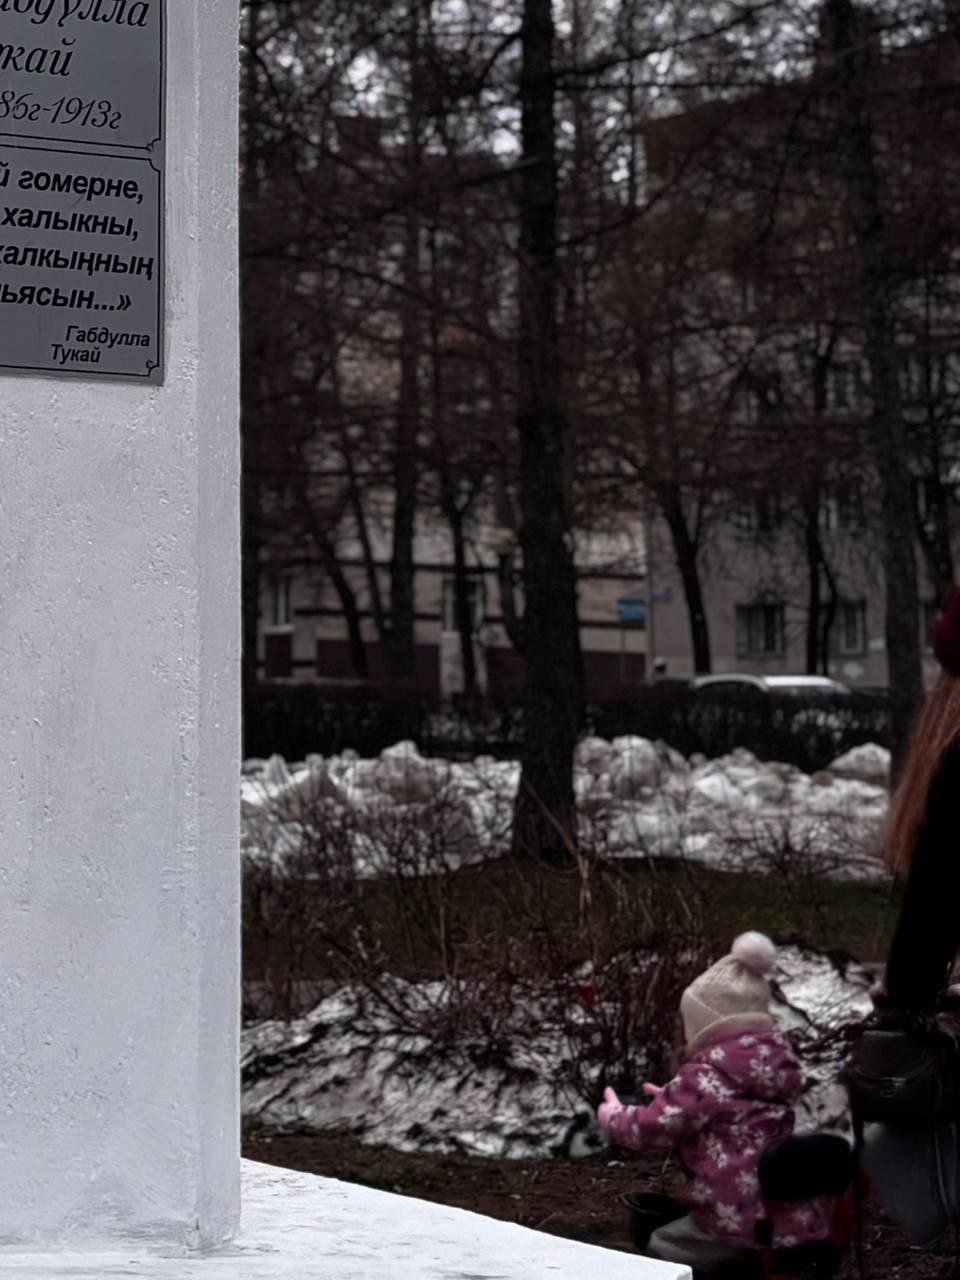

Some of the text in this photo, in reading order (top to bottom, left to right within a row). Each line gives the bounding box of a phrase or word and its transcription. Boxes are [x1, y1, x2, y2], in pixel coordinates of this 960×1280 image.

[17, 169, 144, 204] гомерне,
[0, 205, 138, 242] халыкны,
[65, 325, 151, 349] Габдулла
[50, 343, 101, 365] Тукай
